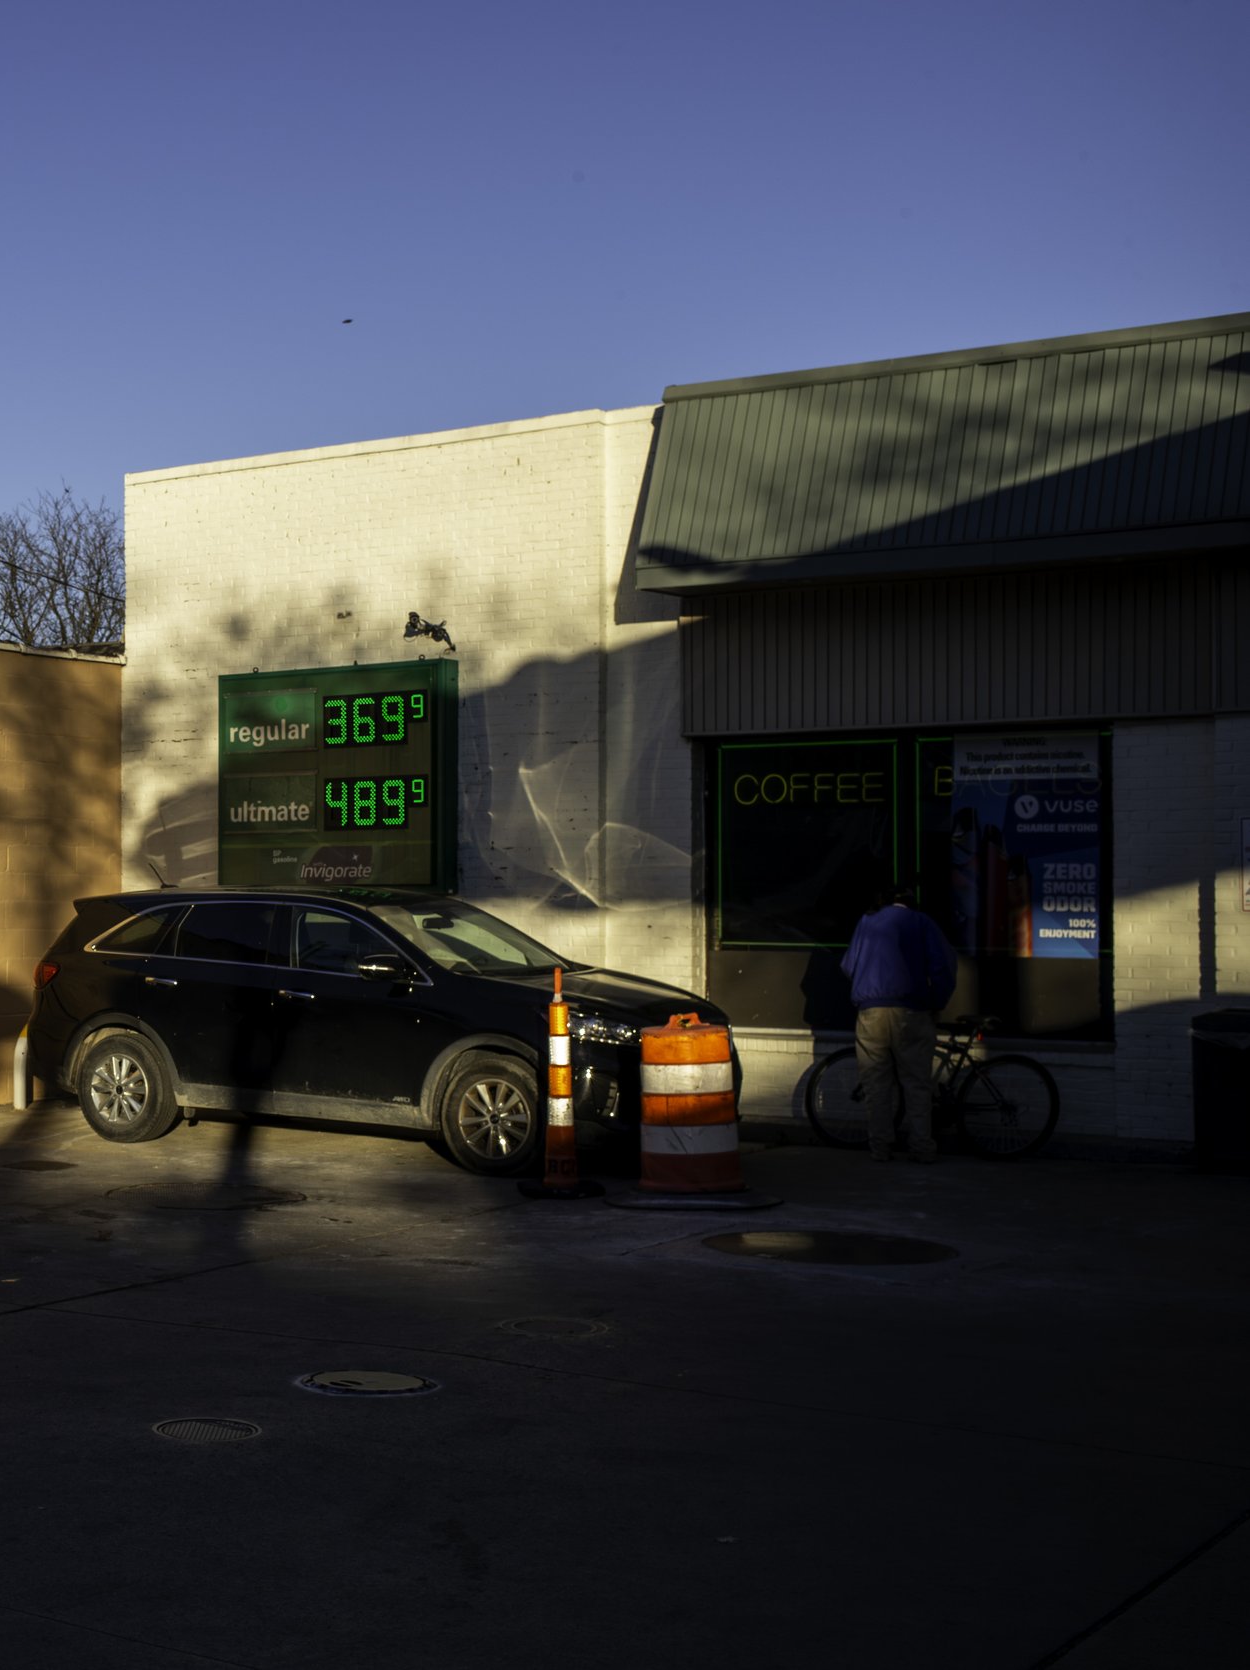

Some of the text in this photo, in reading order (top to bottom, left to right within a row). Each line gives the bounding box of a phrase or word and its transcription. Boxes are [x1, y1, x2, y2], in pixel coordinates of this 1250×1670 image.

[229, 719, 310, 746] regular
[965, 752, 983, 761] This
[983, 751, 1014, 763] product
[1014, 751, 1050, 761] contains
[733, 770, 886, 807] COFFEE
[230, 800, 310, 823] ultimate
[1016, 823, 1098, 833] CHARGE BEYOND
[301, 863, 372, 882] Invigorate
[1043, 863, 1096, 880] ZERO
[1042, 882, 1096, 894] SMOKE
[1042, 896, 1096, 913] ODOR
[1068, 918, 1096, 928] 100%
[1038, 928, 1097, 939] ENJOYMENT
